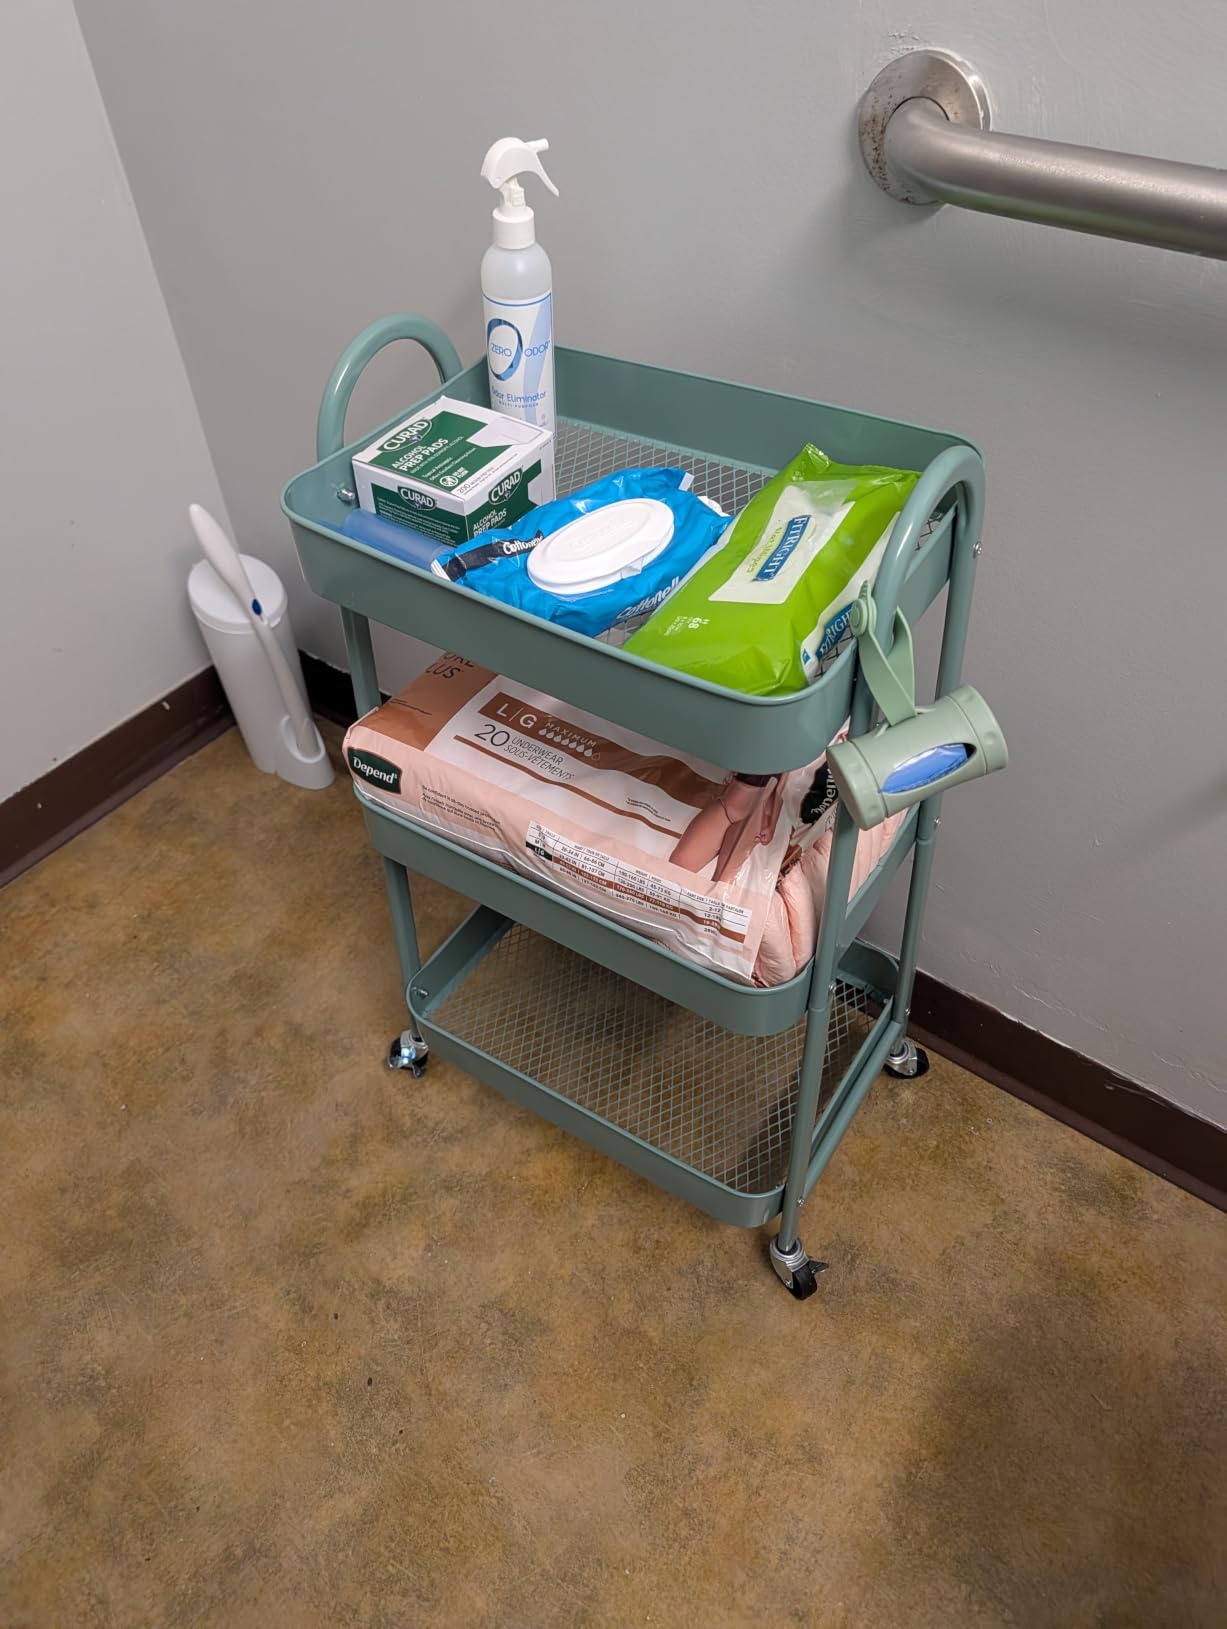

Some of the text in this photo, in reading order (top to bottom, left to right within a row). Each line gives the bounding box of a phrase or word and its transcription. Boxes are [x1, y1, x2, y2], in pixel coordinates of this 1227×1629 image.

[490, 340, 550, 357] ZERO ODOR
[507, 392, 546, 402] Eliminator
[384, 421, 428, 450] CURAD
[392, 446, 426, 468] ALCOHOL
[399, 438, 448, 471] PREP PADS
[400, 488, 434, 507] CURAD
[457, 483, 470, 493] 200
[491, 470, 520, 502] CURAD
[473, 510, 497, 531] ALCOHOL
[490, 508, 507, 527] PADS
[764, 517, 808, 574] FITRIGHT
[496, 703, 537, 728] L G
[474, 724, 510, 746] 20
[545, 722, 597, 747] MAXIMUM
[504, 744, 574, 780] SOUS-VÊTEMENTS
[512, 736, 564, 765] UNDERWEAR
[352, 756, 394, 784] Depend
